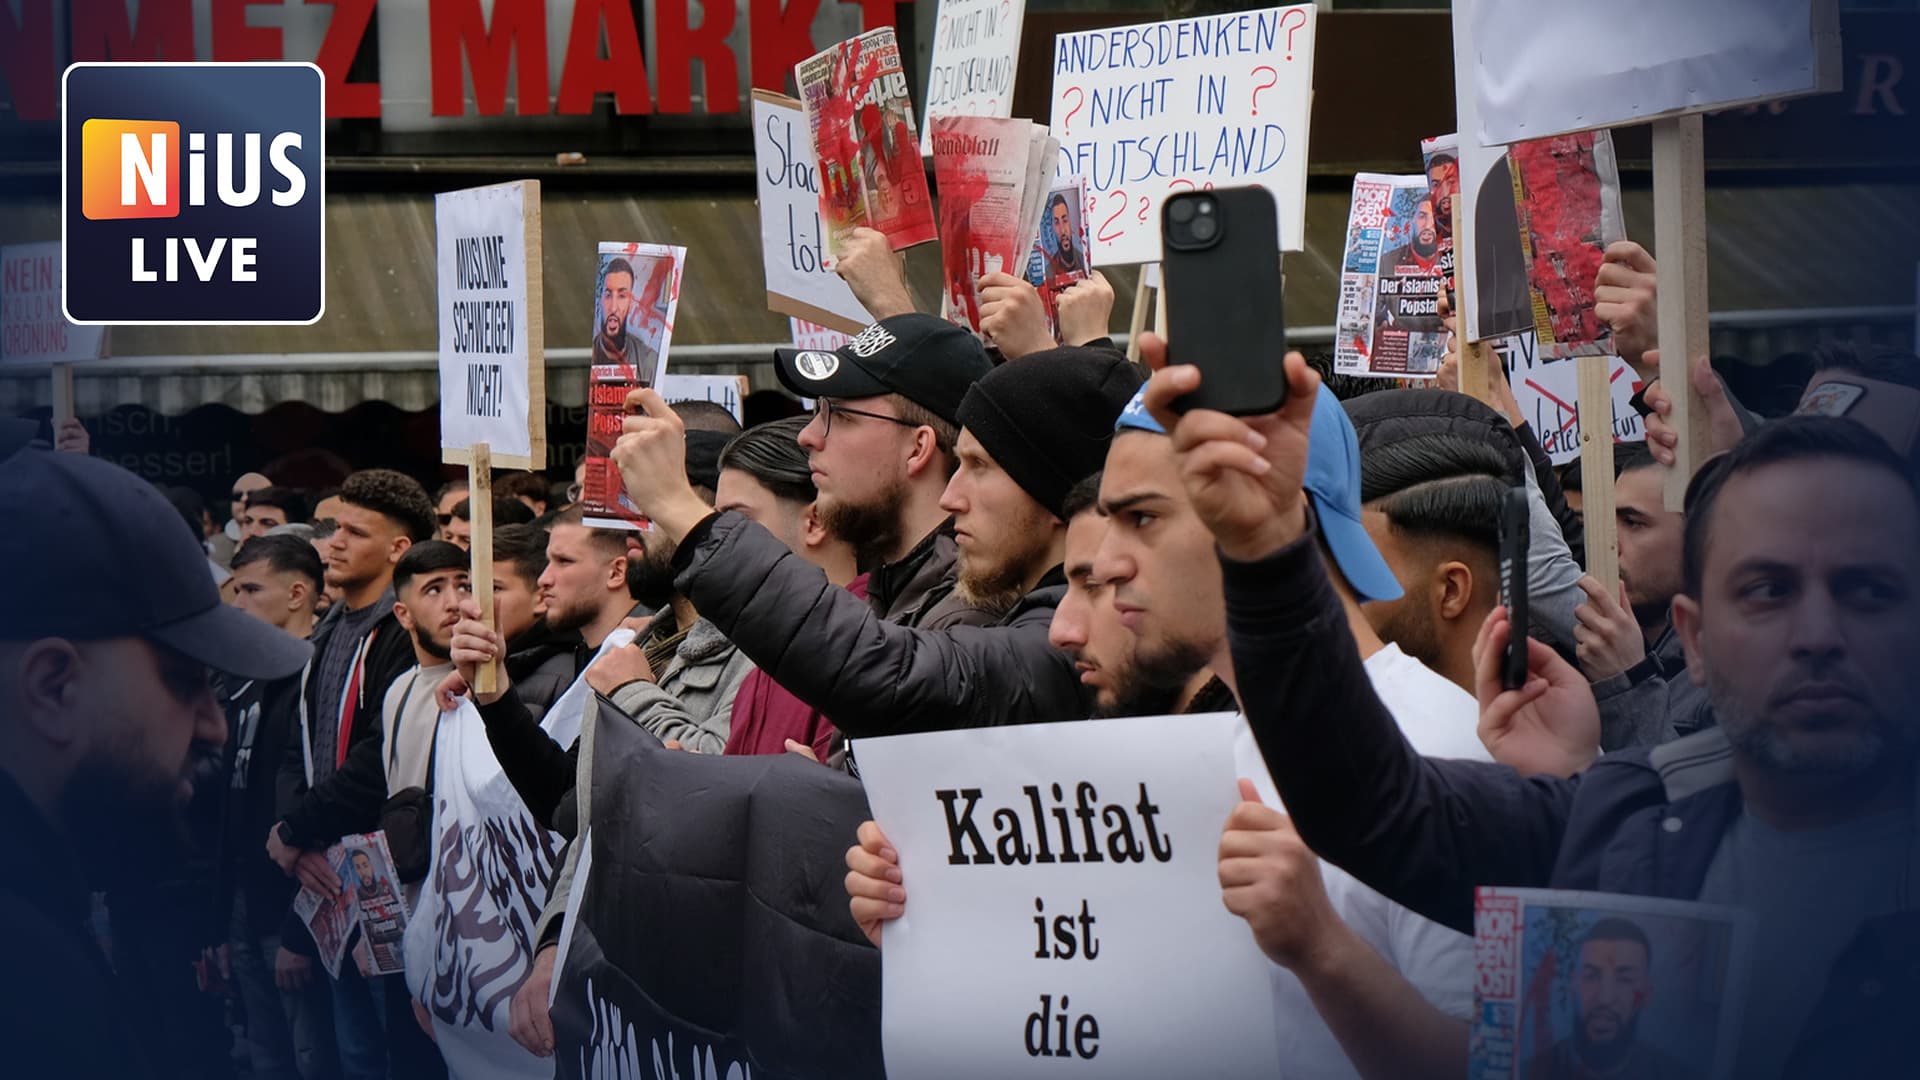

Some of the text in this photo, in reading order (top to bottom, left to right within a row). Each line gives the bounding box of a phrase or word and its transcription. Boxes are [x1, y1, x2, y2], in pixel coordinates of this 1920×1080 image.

[1090, 78, 1175, 128] NICHT
[1197, 74, 1227, 115] IN
[932, 133, 1000, 157] bendblatt
[4, 256, 53, 293] NEIN
[456, 235, 509, 290] MUSLIME
[1380, 278, 1400, 294] Der
[1401, 276, 1440, 294] Islamis
[4, 320, 68, 355] ORDNUNG
[453, 300, 515, 354] SCHWEIGEN
[466, 363, 503, 418] NICHT!
[593, 410, 627, 435] Pops
[935, 781, 1172, 866] Kalifat
[1033, 897, 1100, 961] ist
[1023, 994, 1101, 1060] die
